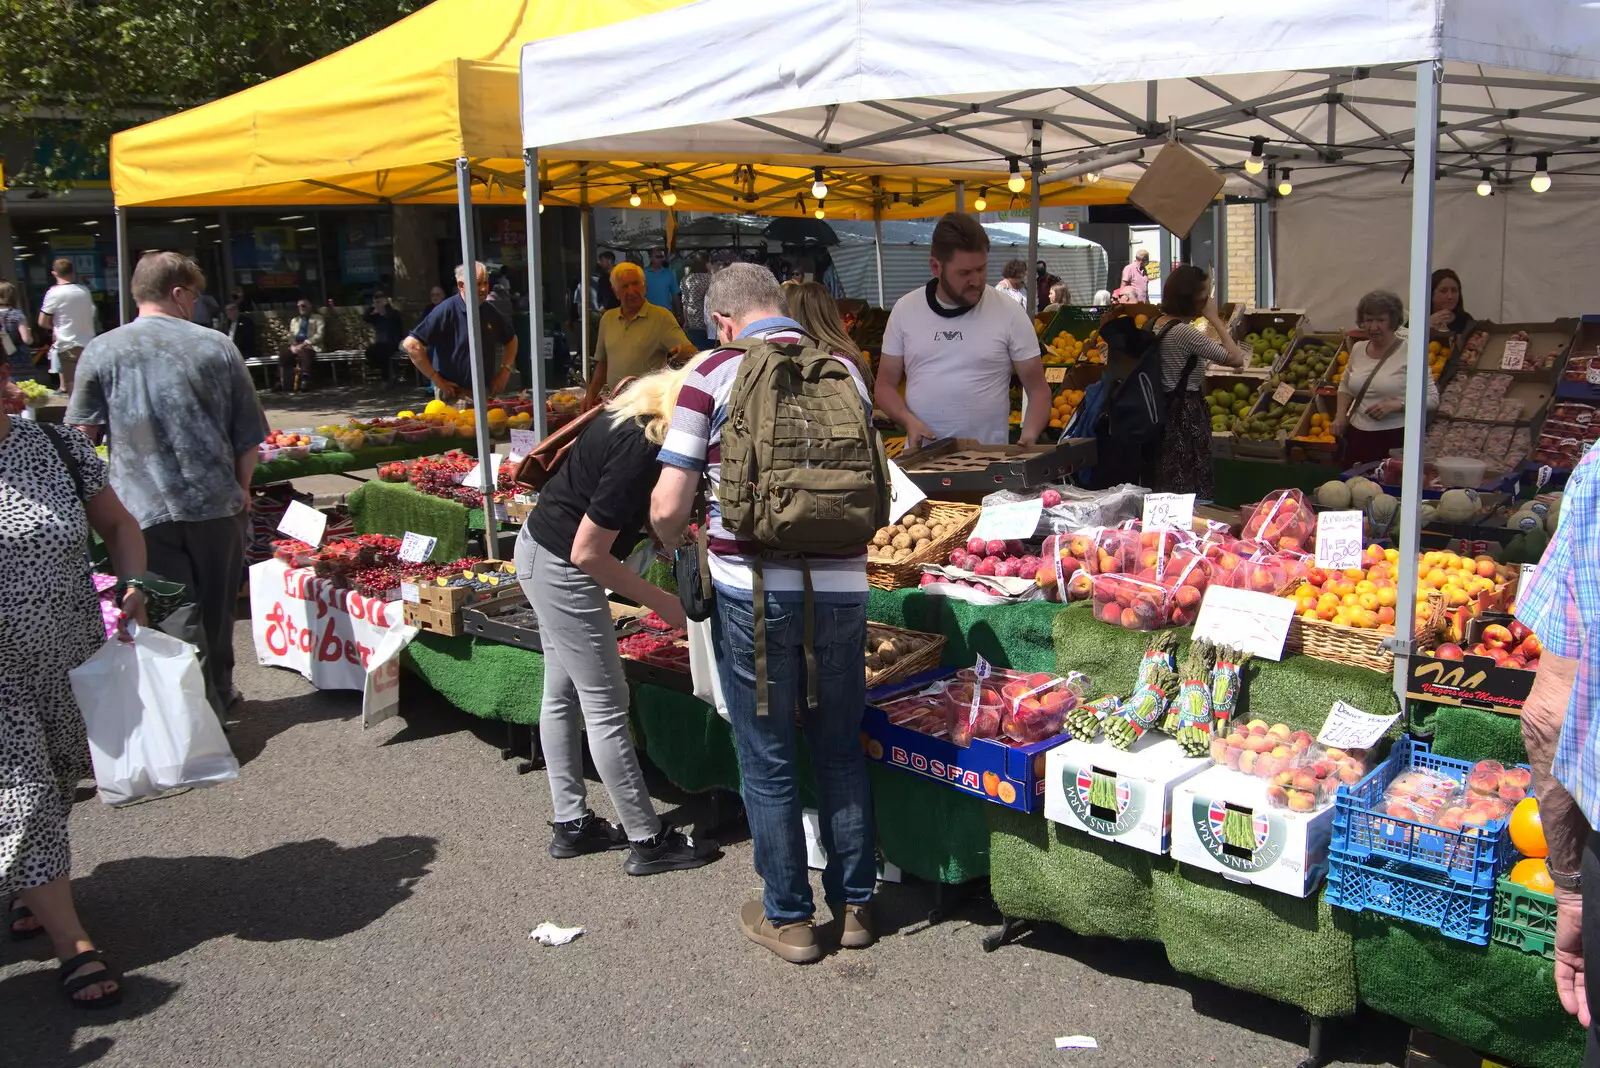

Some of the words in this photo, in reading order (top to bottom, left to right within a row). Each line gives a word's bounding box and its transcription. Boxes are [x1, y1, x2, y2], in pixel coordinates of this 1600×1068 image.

[1421, 682, 1457, 696] Vergers
[1458, 689, 1474, 699] des
[891, 746, 980, 789] BOSFA
[1066, 786, 1088, 821] FARM
[1089, 818, 1129, 834] JOHNS
[1197, 819, 1222, 857] FARM
[1223, 854, 1268, 870] JOHNS
